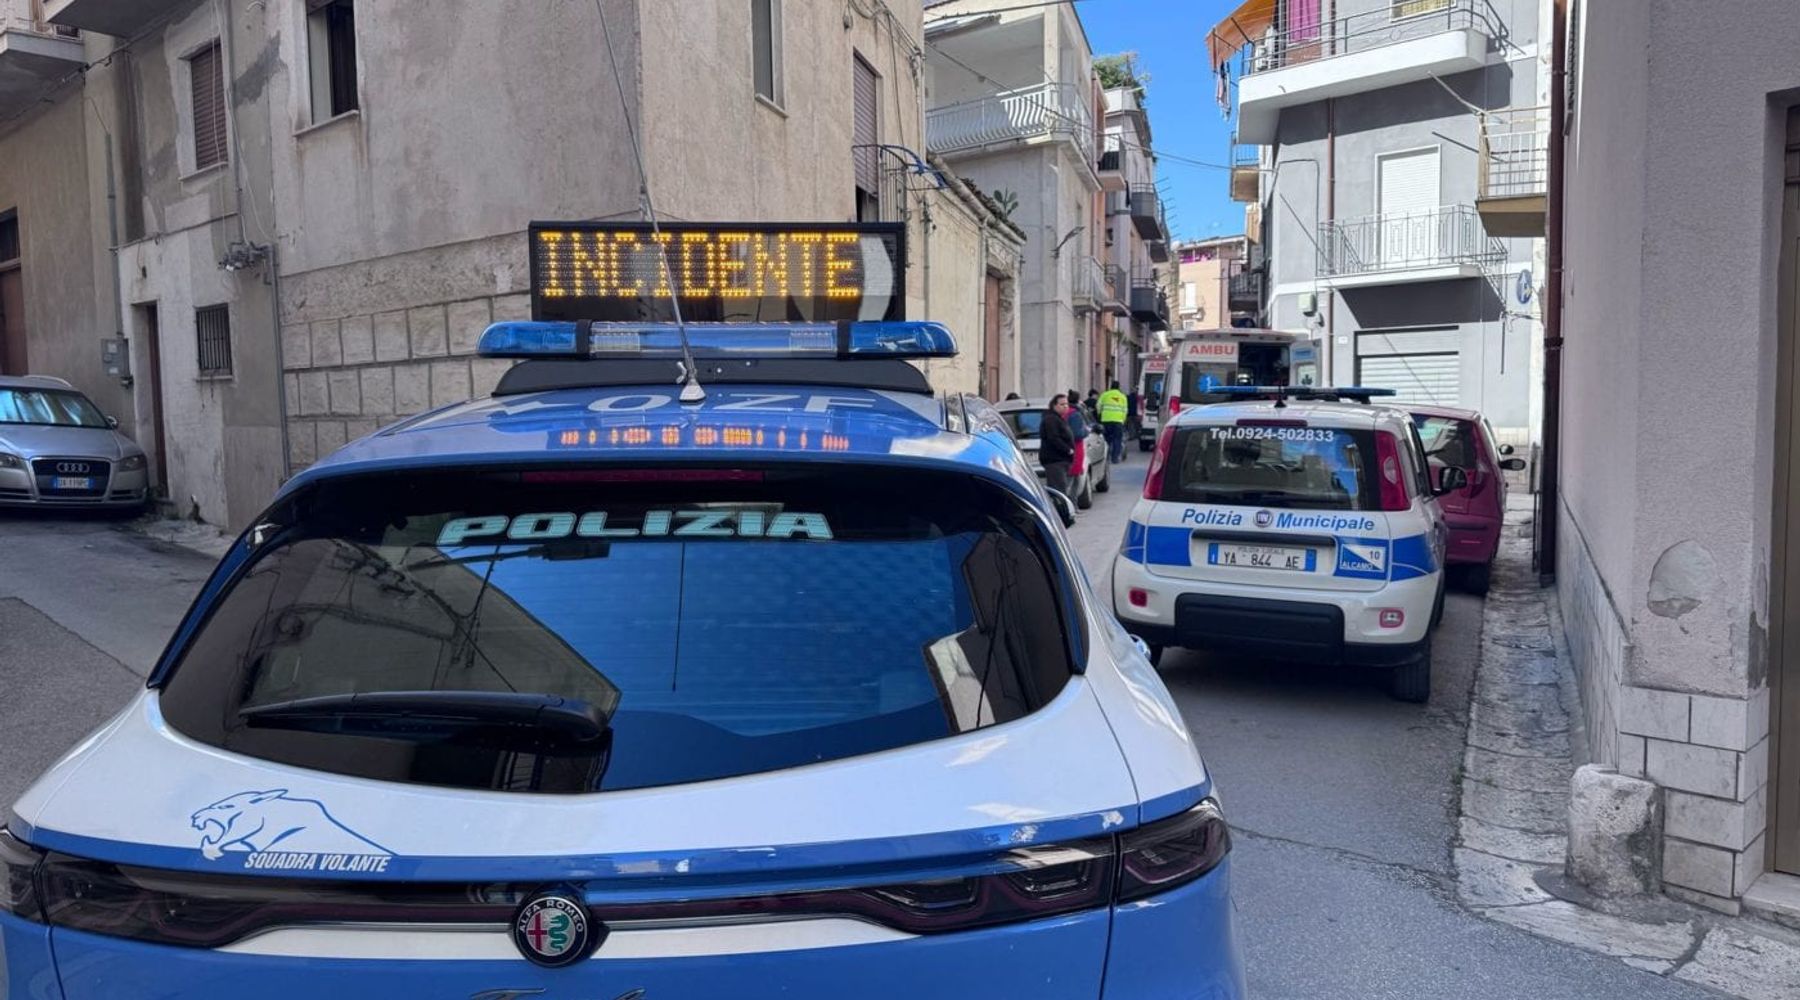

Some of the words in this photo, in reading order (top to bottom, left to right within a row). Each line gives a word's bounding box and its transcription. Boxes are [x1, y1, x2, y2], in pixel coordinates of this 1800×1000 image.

[540, 232, 859, 298] INCIDENTE
[1189, 344, 1235, 356] AMBU
[1210, 428, 1334, 442] Tel.0924-502833
[436, 511, 833, 545] POLIZIA
[1181, 508, 1243, 526] Polizia
[1276, 512, 1375, 531] Municipale
[1223, 551, 1237, 565] YA
[1250, 553, 1272, 567] 844
[1285, 556, 1300, 569] AE
[1369, 550, 1380, 560] 10
[1341, 560, 1373, 570] ALCAMO
[244, 851, 316, 870] SQUADRA
[319, 854, 391, 872] VOLANTE
[520, 904, 540, 933] ALFA
[546, 899, 584, 932] ROMEO
